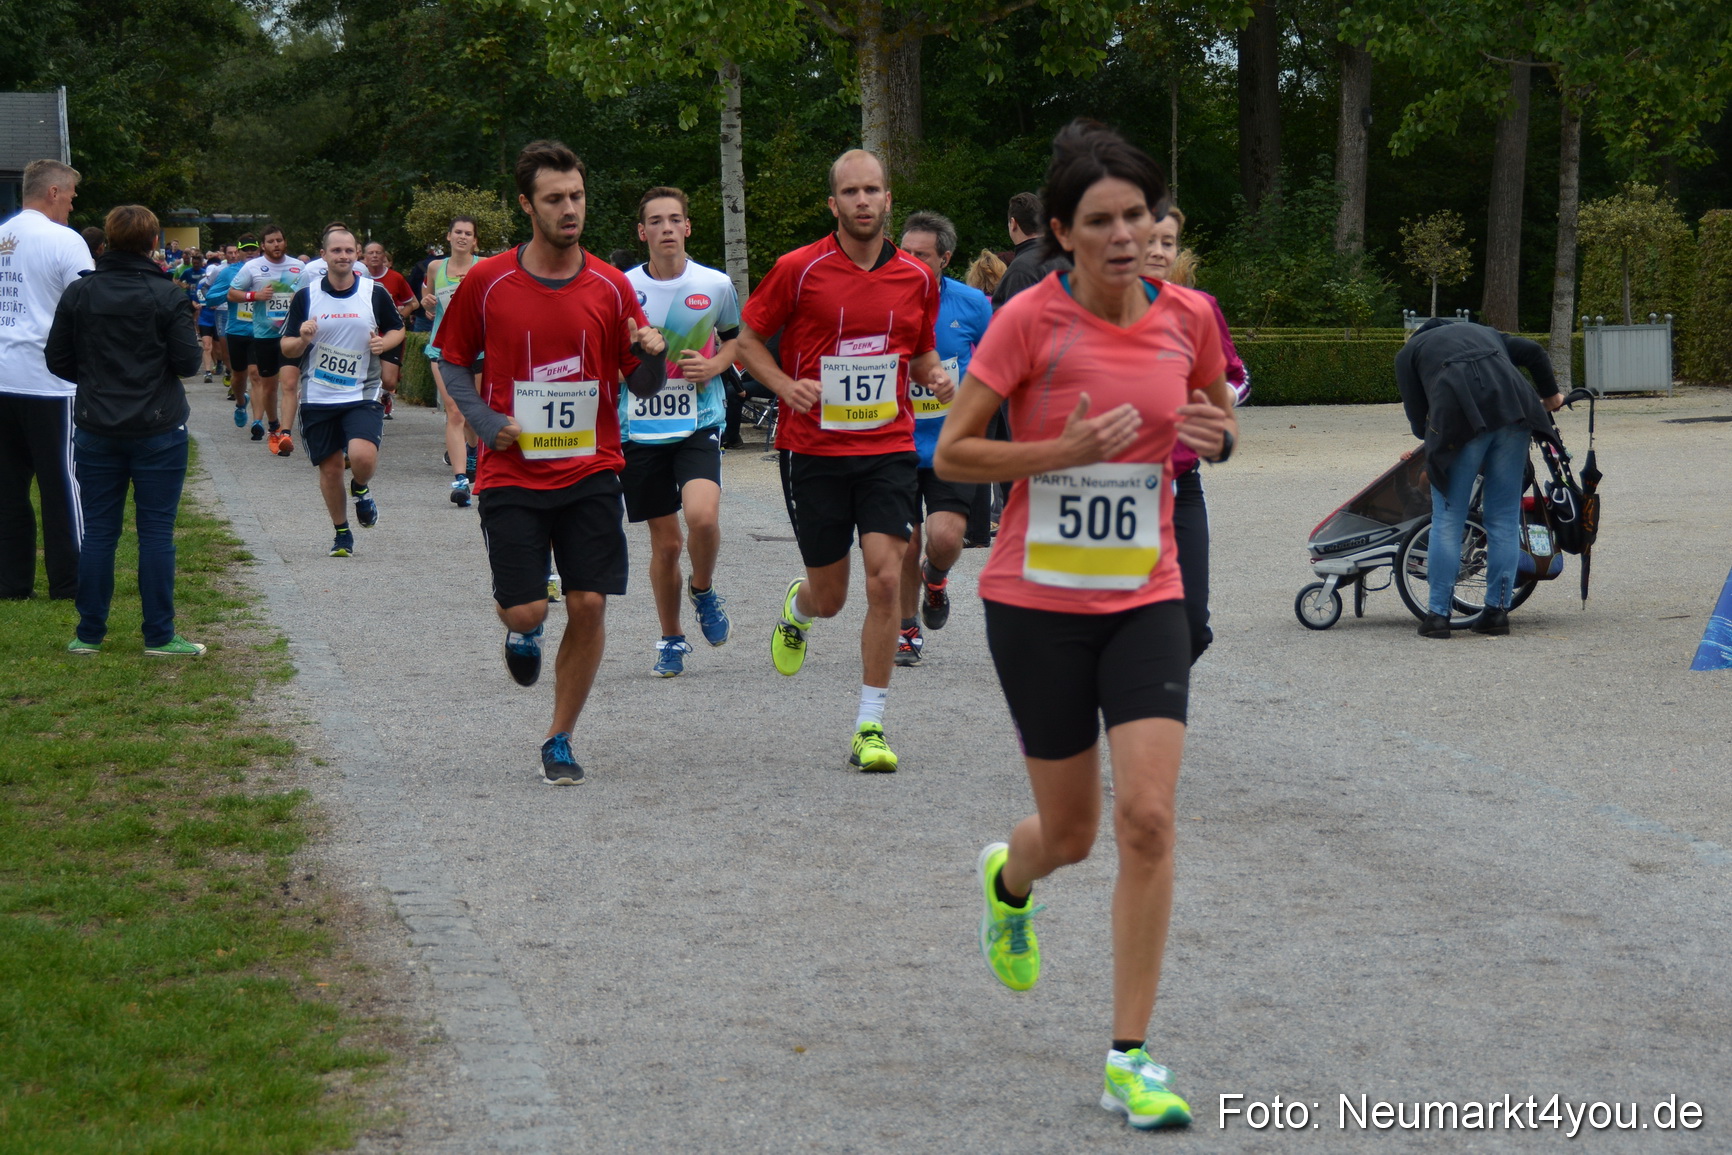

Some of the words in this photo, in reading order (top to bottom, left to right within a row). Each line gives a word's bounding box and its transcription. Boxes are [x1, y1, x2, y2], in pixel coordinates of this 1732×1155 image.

[1, 256, 11, 267] IM
[852, 341, 873, 351] DEHN
[320, 353, 357, 376] 2694
[546, 364, 569, 376] DEHN
[852, 363, 888, 371] Neumarkt
[516, 388, 545, 397] PARTL
[547, 389, 587, 397] Neumarkt
[839, 374, 886, 402] 157
[634, 393, 691, 417] 3098
[922, 402, 940, 411] Max
[542, 400, 575, 429] 15
[845, 408, 879, 419] Tobias
[533, 435, 579, 448] Matthias
[1033, 474, 1077, 487] PARTL
[1081, 476, 1141, 489] Neumarkt
[1058, 495, 1137, 541] 506
